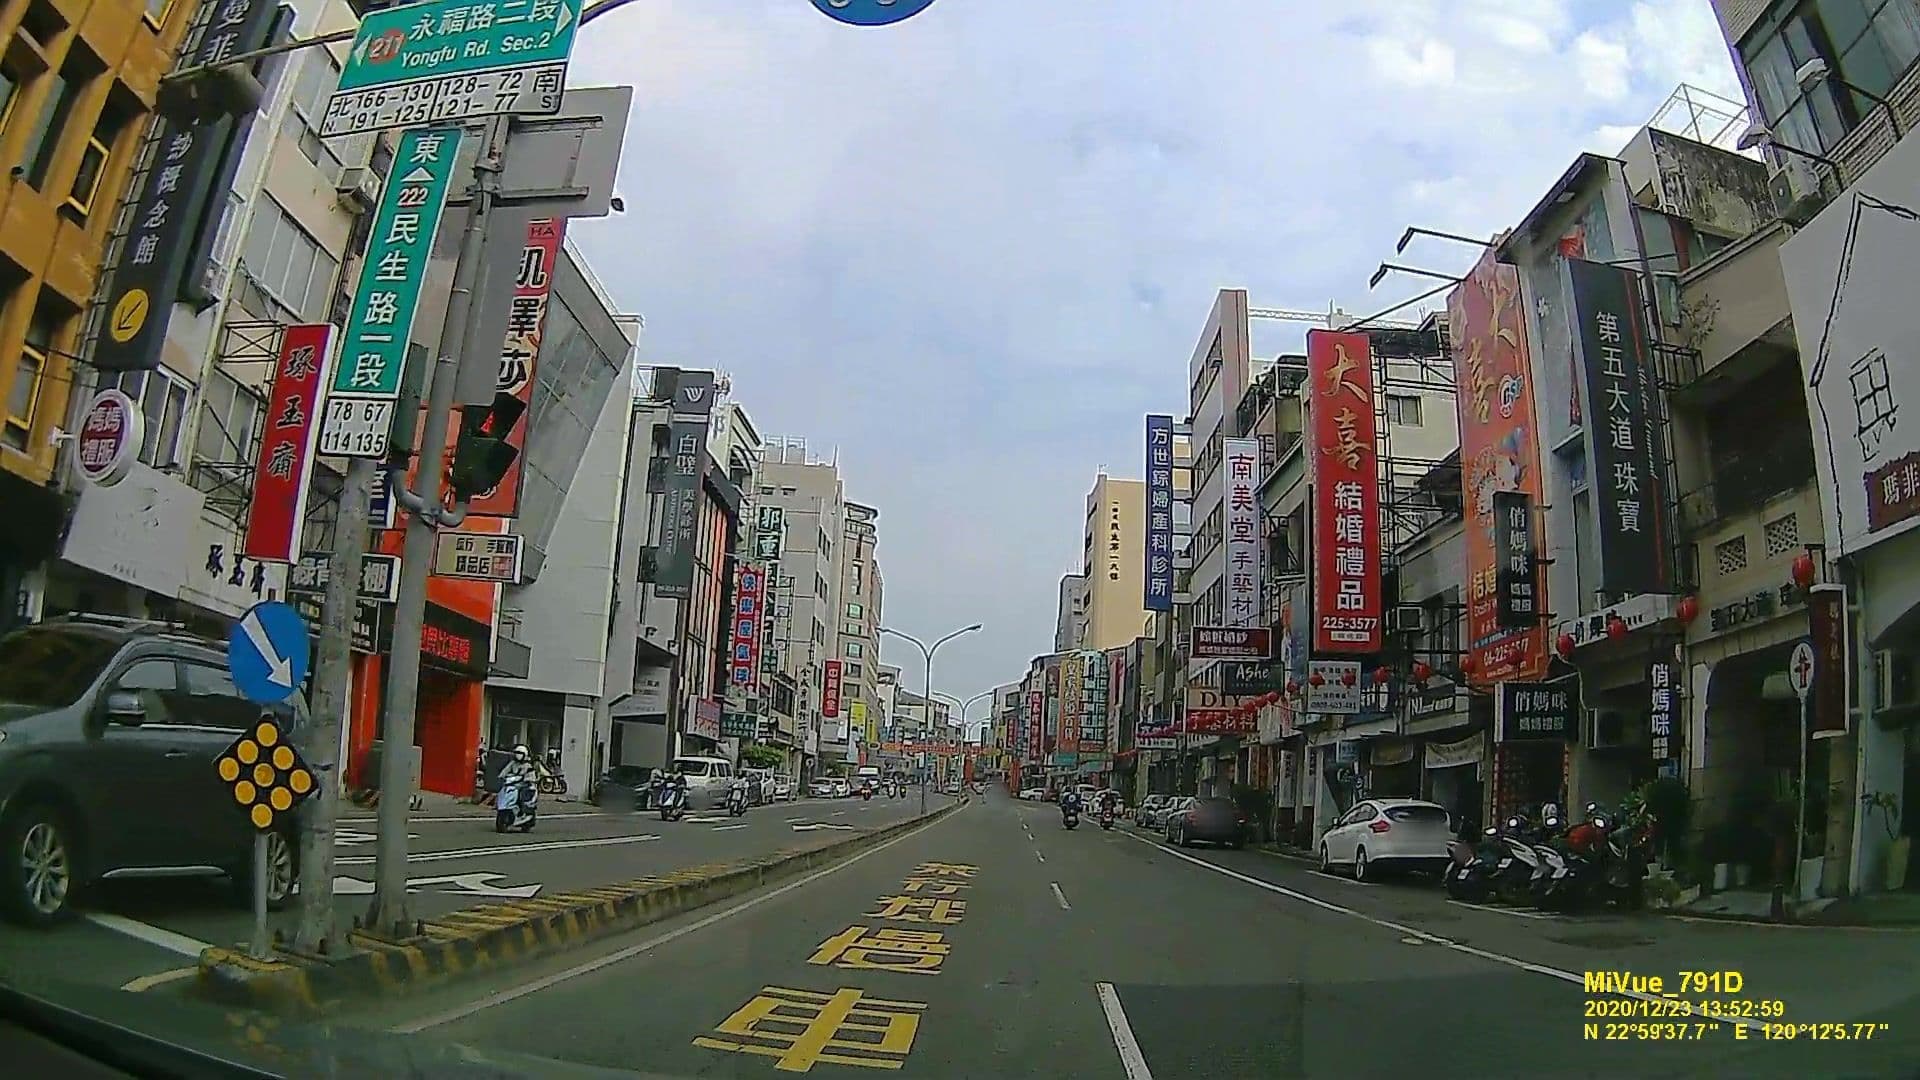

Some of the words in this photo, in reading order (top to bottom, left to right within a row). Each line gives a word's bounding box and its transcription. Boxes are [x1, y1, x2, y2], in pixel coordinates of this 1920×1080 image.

[409, 0, 558, 41] 永福路二段
[401, 47, 457, 69] Yongfu
[464, 42, 490, 57] Rd.
[500, 32, 551, 52] Sec.2
[329, 97, 353, 118] 北
[356, 83, 433, 108] 166-130
[533, 71, 559, 93] 南
[349, 104, 426, 129] 191-125
[410, 134, 445, 164] 東
[397, 187, 428, 207] 222
[351, 213, 421, 389] 民生路一段
[333, 402, 352, 421] 78
[364, 403, 386, 422] 67
[1596, 311, 1641, 533] 第五大道珠寶
[323, 432, 351, 451] 114
[356, 434, 386, 453] 135
[1334, 481, 1366, 611] 結婚禮品
[1509, 506, 1530, 576] 俏媽咪
[1322, 616, 1378, 630] 225-3577
[1236, 664, 1270, 681] Ashe
[1200, 691, 1242, 707] DIY
[1515, 691, 1567, 713] 俏媽咪
[1651, 664, 1670, 736] 俏媽咪
